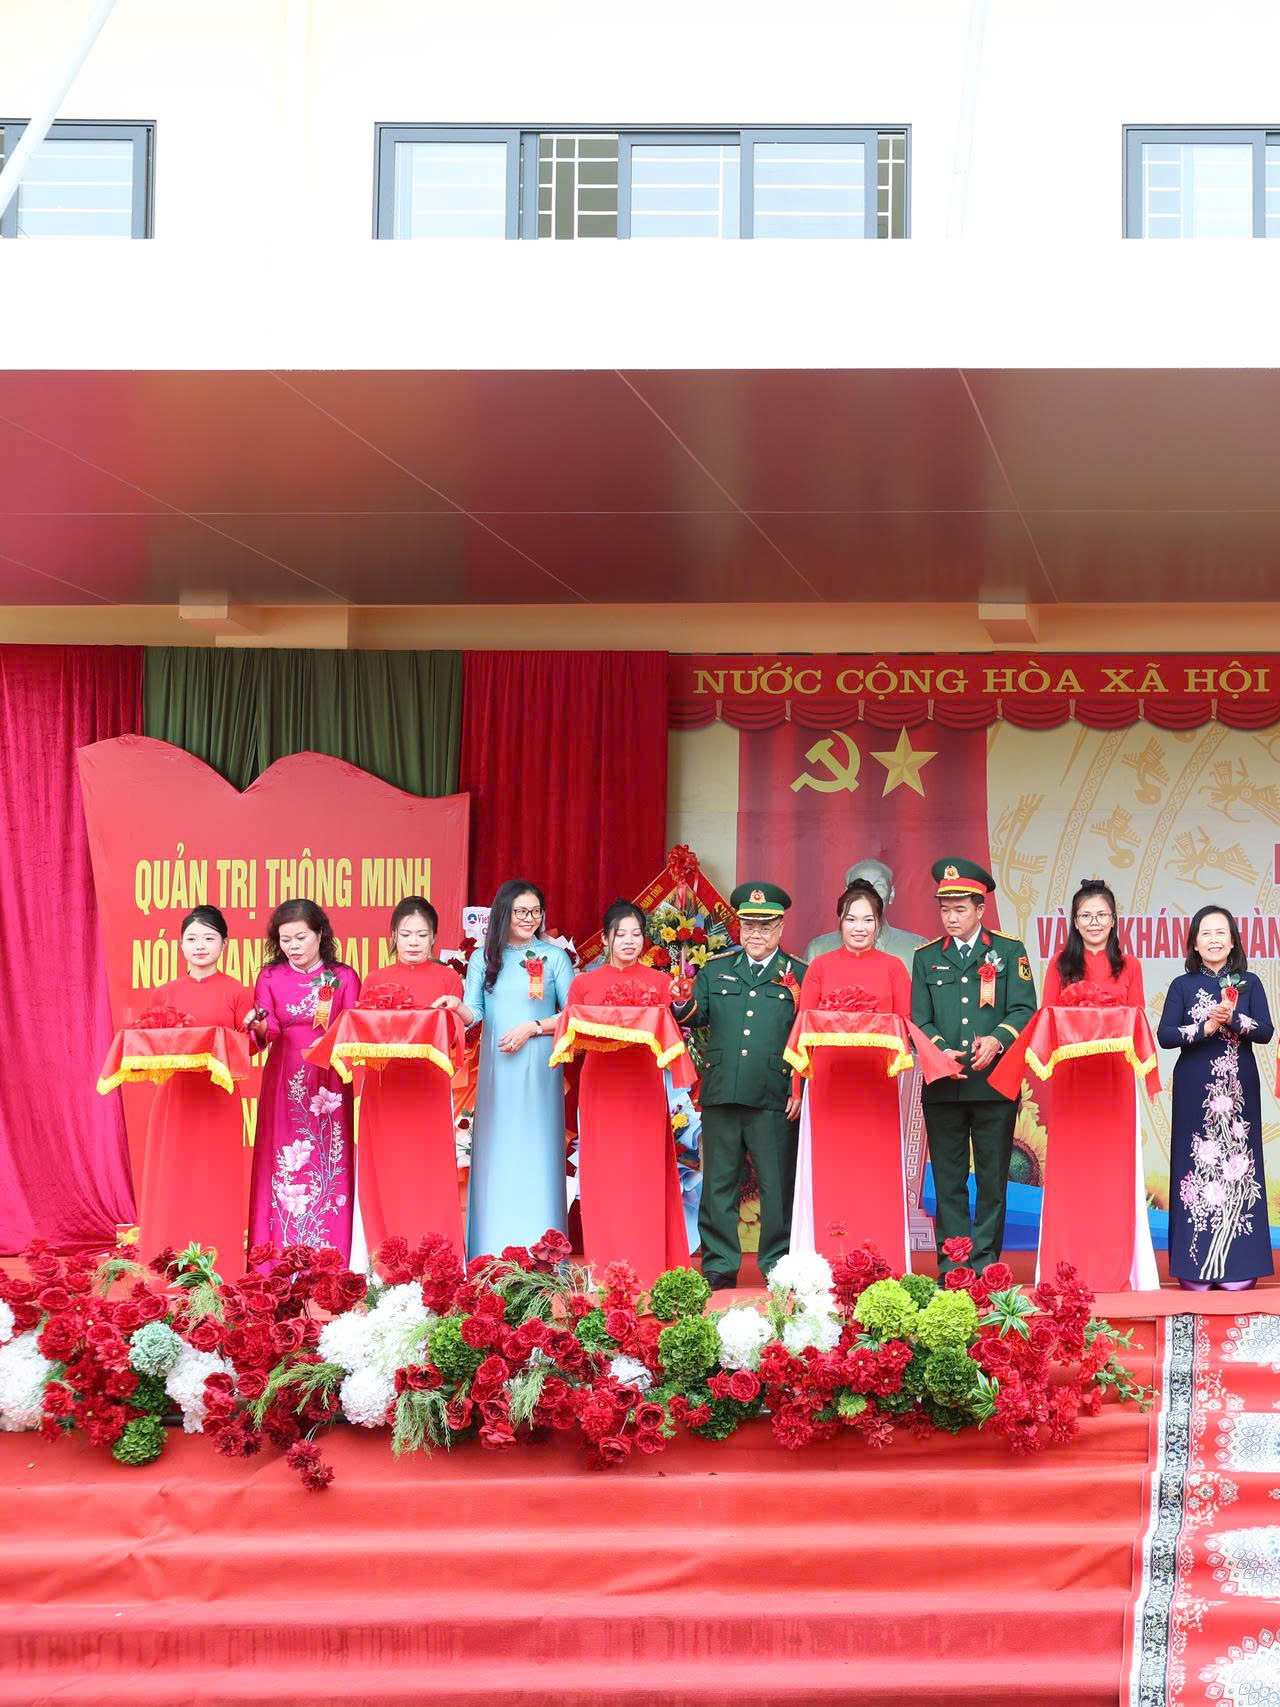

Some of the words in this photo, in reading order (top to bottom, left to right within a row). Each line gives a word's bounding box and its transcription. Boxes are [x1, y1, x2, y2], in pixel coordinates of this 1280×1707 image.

[693, 662, 822, 694] NƯỚC
[836, 661, 969, 700] CỘNG
[982, 660, 1085, 693] HÒA
[1099, 662, 1169, 693] XÃ
[1184, 660, 1270, 699] HỘI
[135, 842, 208, 915] QUẢN
[216, 859, 257, 920] TRỊ
[266, 847, 352, 908] THÔNG
[361, 858, 432, 907] MINH
[132, 928, 178, 989] NÓI
[1118, 908, 1191, 958] KHÁN
